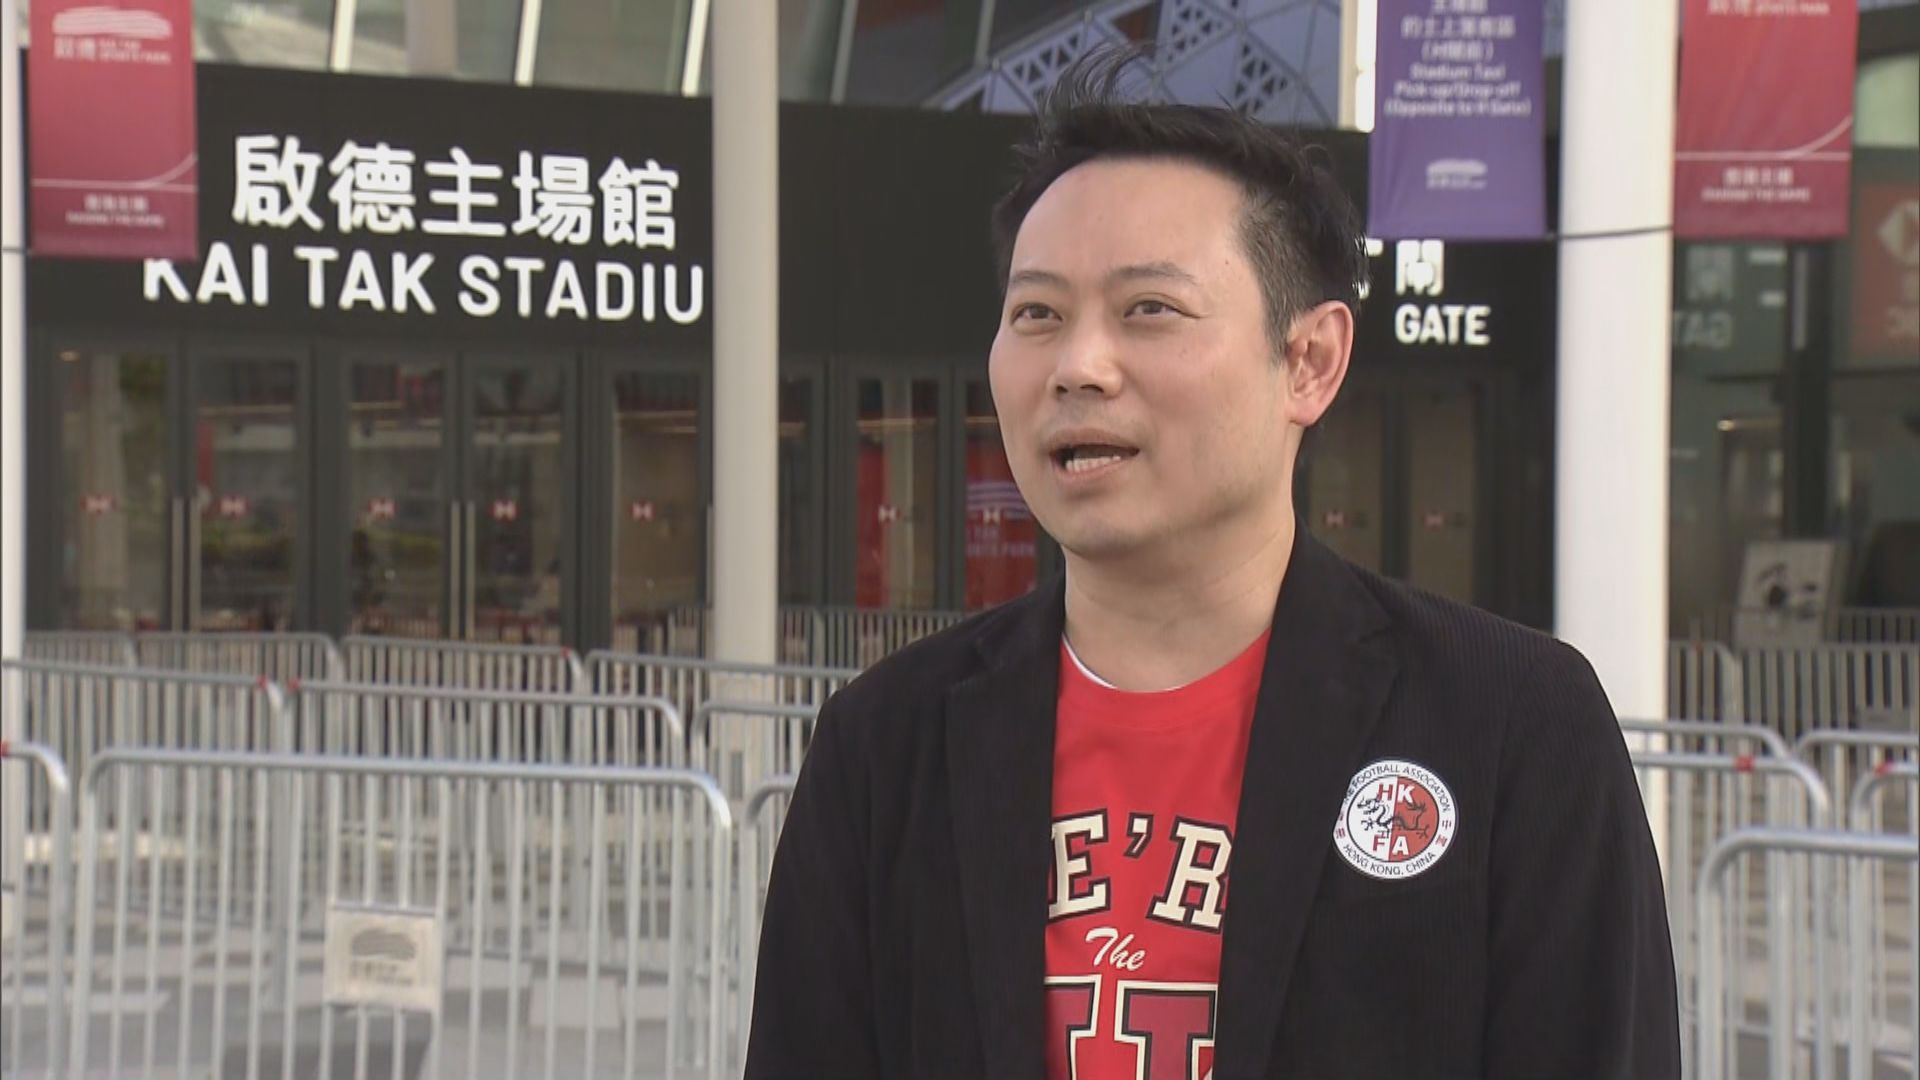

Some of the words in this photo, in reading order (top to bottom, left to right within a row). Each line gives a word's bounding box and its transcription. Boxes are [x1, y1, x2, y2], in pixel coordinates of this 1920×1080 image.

[231, 134, 680, 251] 啟德主場館
[143, 243, 270, 306] KAI
[293, 246, 436, 315] TAK
[457, 255, 705, 325] STADIU
[1395, 303, 1490, 346] GATE
[1351, 764, 1401, 792] FOOTBALL
[1402, 765, 1452, 812] ASSOCIATION
[1342, 842, 1369, 869] HONG
[1405, 850, 1437, 875] CHINA
[1085, 926, 1147, 972] The
